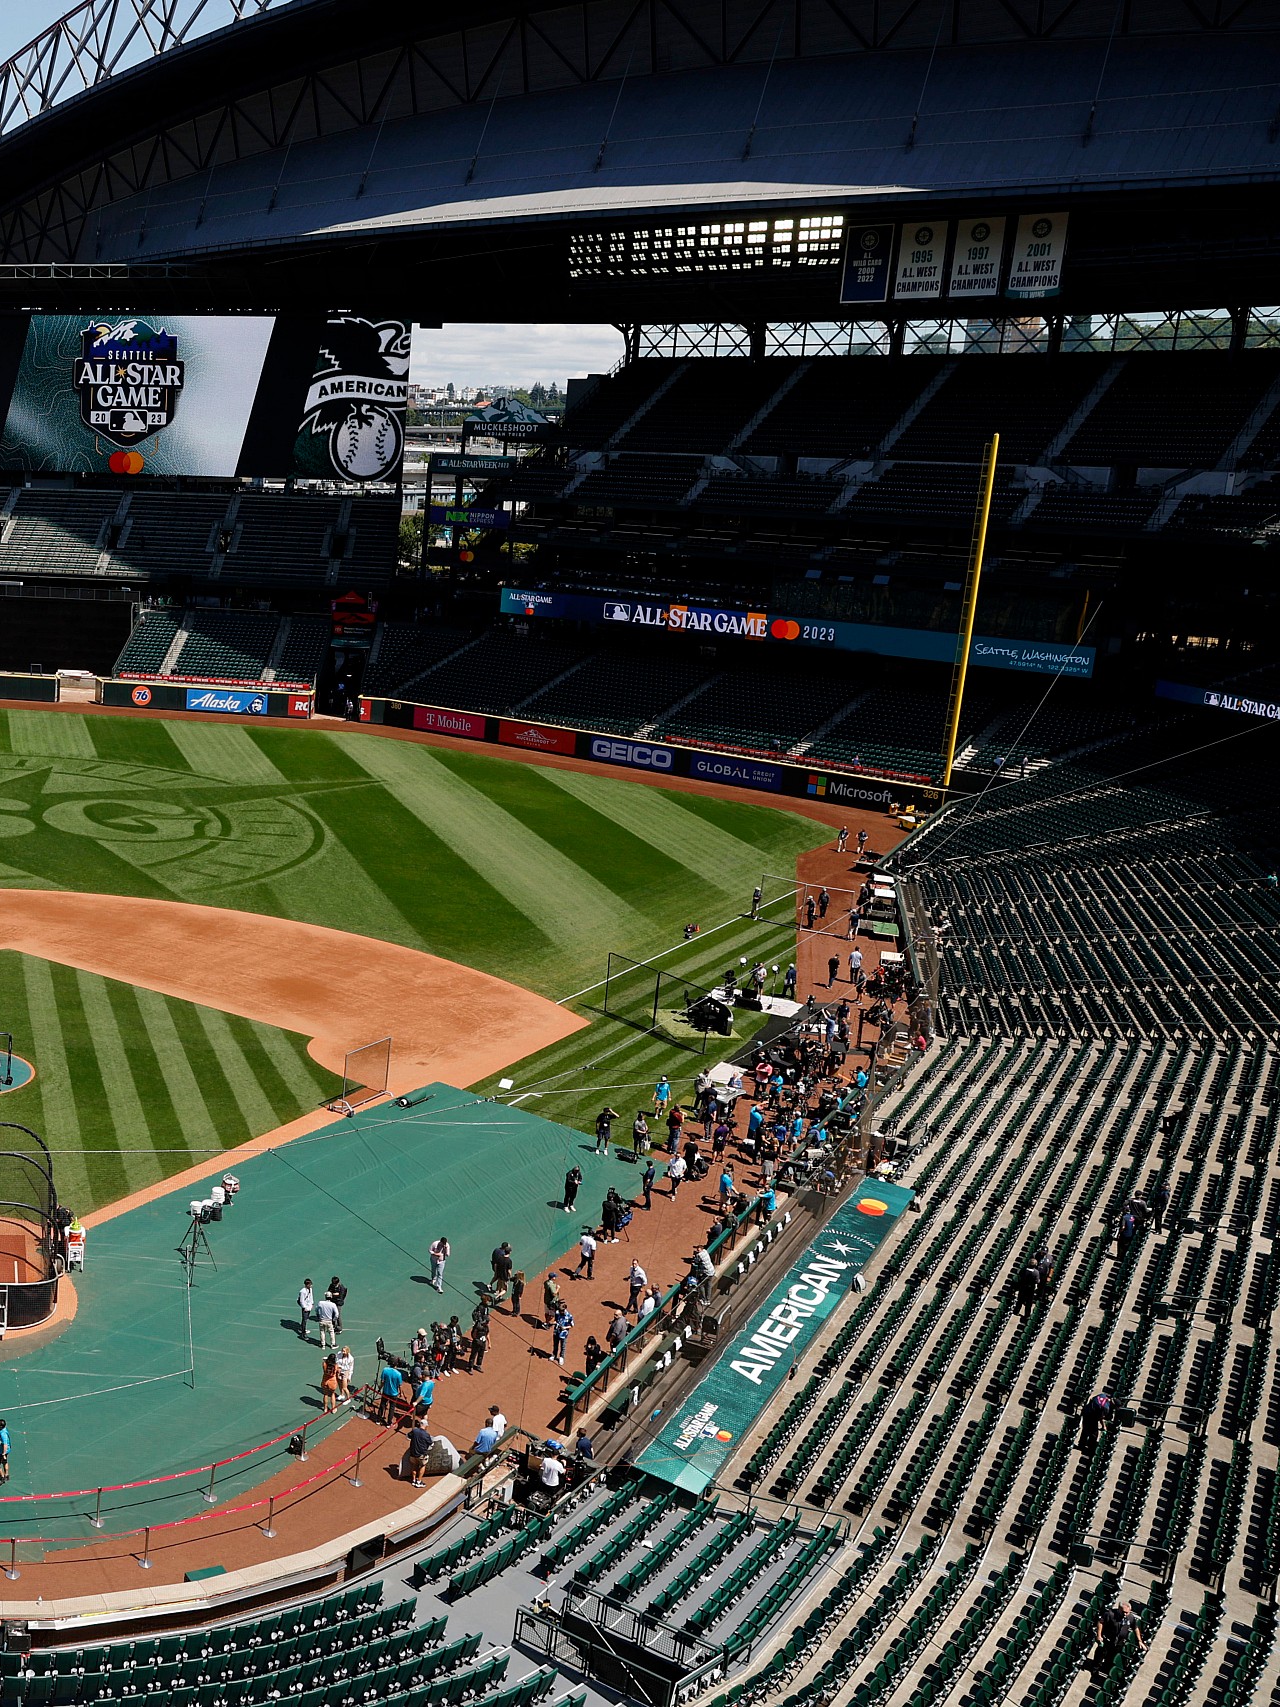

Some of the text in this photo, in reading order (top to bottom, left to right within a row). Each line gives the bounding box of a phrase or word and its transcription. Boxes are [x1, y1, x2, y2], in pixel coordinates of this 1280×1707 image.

[911, 250, 933, 264] 1995
[967, 247, 990, 261] 1997
[1026, 243, 1051, 257] 2001
[902, 265, 938, 279] A.L. WEST
[957, 262, 994, 276] A.L. WEST
[1017, 259, 1056, 273] A.L. WEST
[857, 274, 874, 283] 2022
[951, 277, 996, 291] CHAMPIONS
[1010, 274, 1058, 288] CHAMPIONS
[896, 280, 939, 293] CHAMPIONS
[108, 350, 154, 360] SEATTLE
[318, 380, 408, 398] AMERICAN
[97, 385, 161, 408] GAME
[95, 413, 162, 423] 20 23
[473, 423, 538, 433] MUCKLESHOOT
[478, 460, 498, 469] WEEK
[535, 595, 553, 604] GAME
[713, 612, 768, 637] GAME
[803, 625, 835, 641] 2023
[134, 690, 148, 701] 76
[190, 693, 241, 711] Alaska
[391, 702, 402, 710] 380
[436, 715, 471, 732] Mobile
[592, 740, 672, 768] GEICO
[697, 761, 775, 779] GLOBAL CREDIT
[752, 775, 772, 783] UNION
[829, 781, 893, 804] Microsoft
[922, 789, 939, 800] 326
[729, 1254, 848, 1385] AMERICAN
[694, 1401, 720, 1422] GAME
